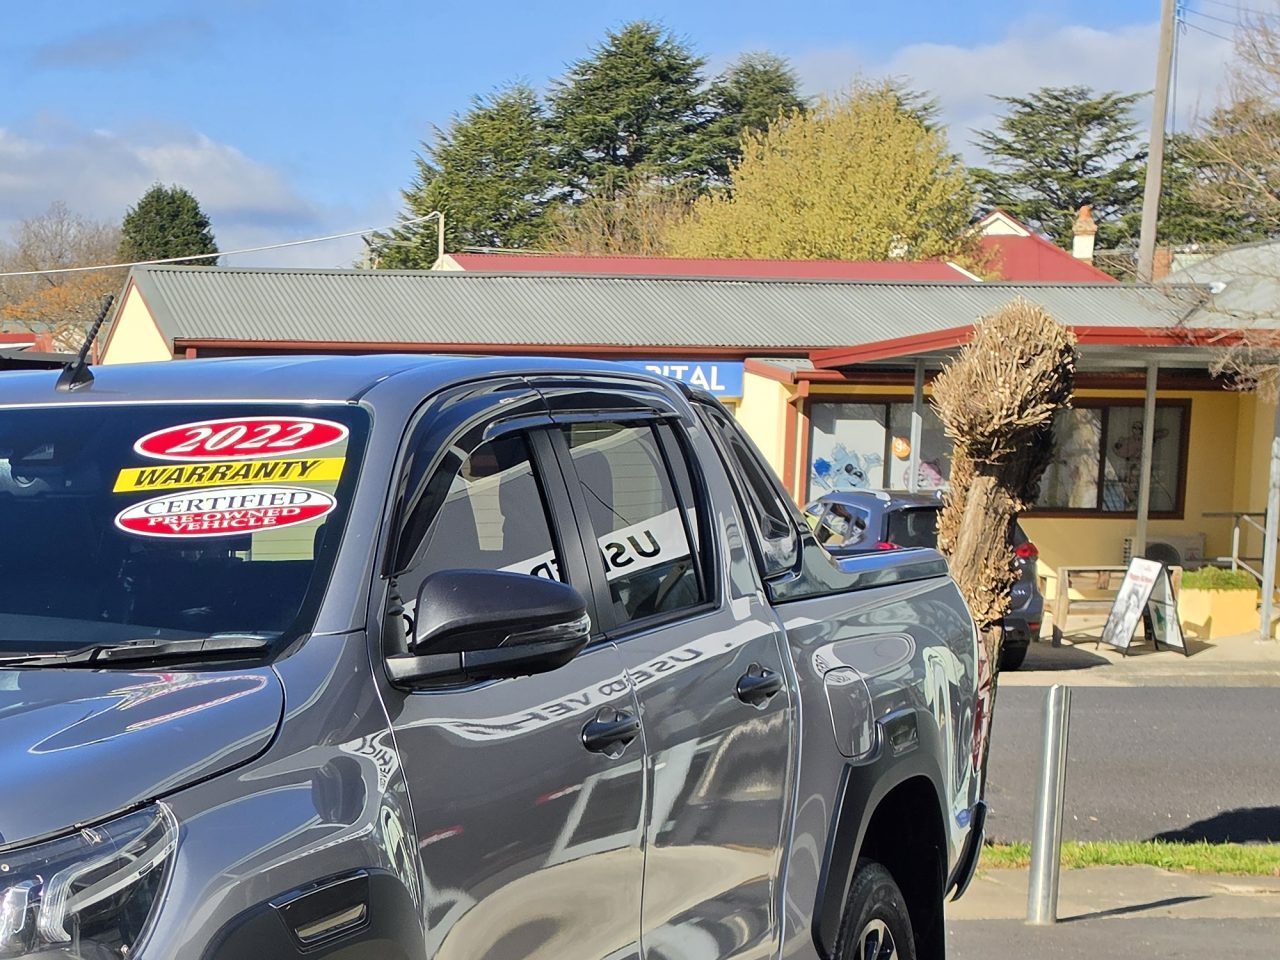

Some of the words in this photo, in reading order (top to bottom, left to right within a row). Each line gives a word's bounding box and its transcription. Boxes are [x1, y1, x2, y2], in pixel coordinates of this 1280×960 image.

[165, 424, 315, 453] 2022
[133, 459, 322, 487] WARRANTY
[144, 491, 312, 515] CERTIFIED
[148, 507, 301, 526] PRE-OWNED
[169, 516, 277, 532] VEHICLE
